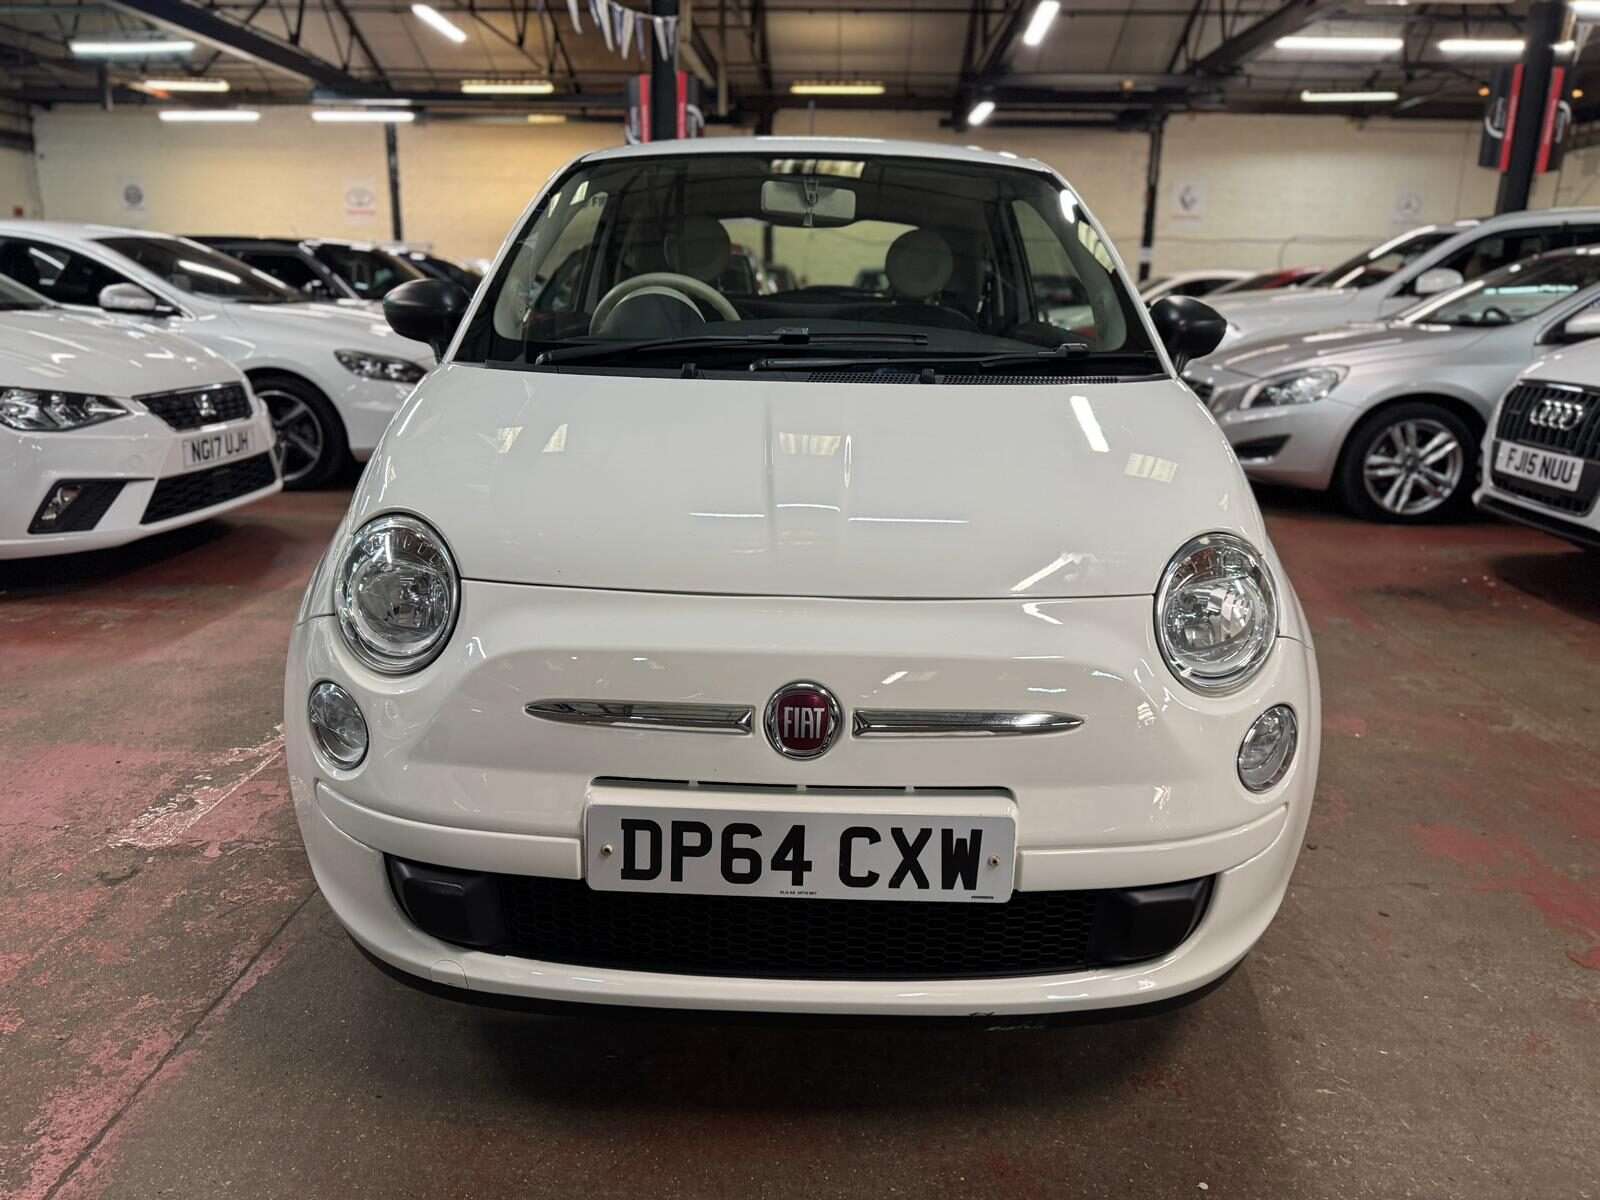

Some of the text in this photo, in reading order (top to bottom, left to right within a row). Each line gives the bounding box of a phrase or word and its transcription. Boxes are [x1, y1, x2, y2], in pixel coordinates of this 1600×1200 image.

[191, 431, 249, 463] NG17 UJH
[1505, 447, 1576, 484] FJ15 NUU
[783, 706, 825, 739] FIAT
[620, 818, 984, 891] DP64 CXW
